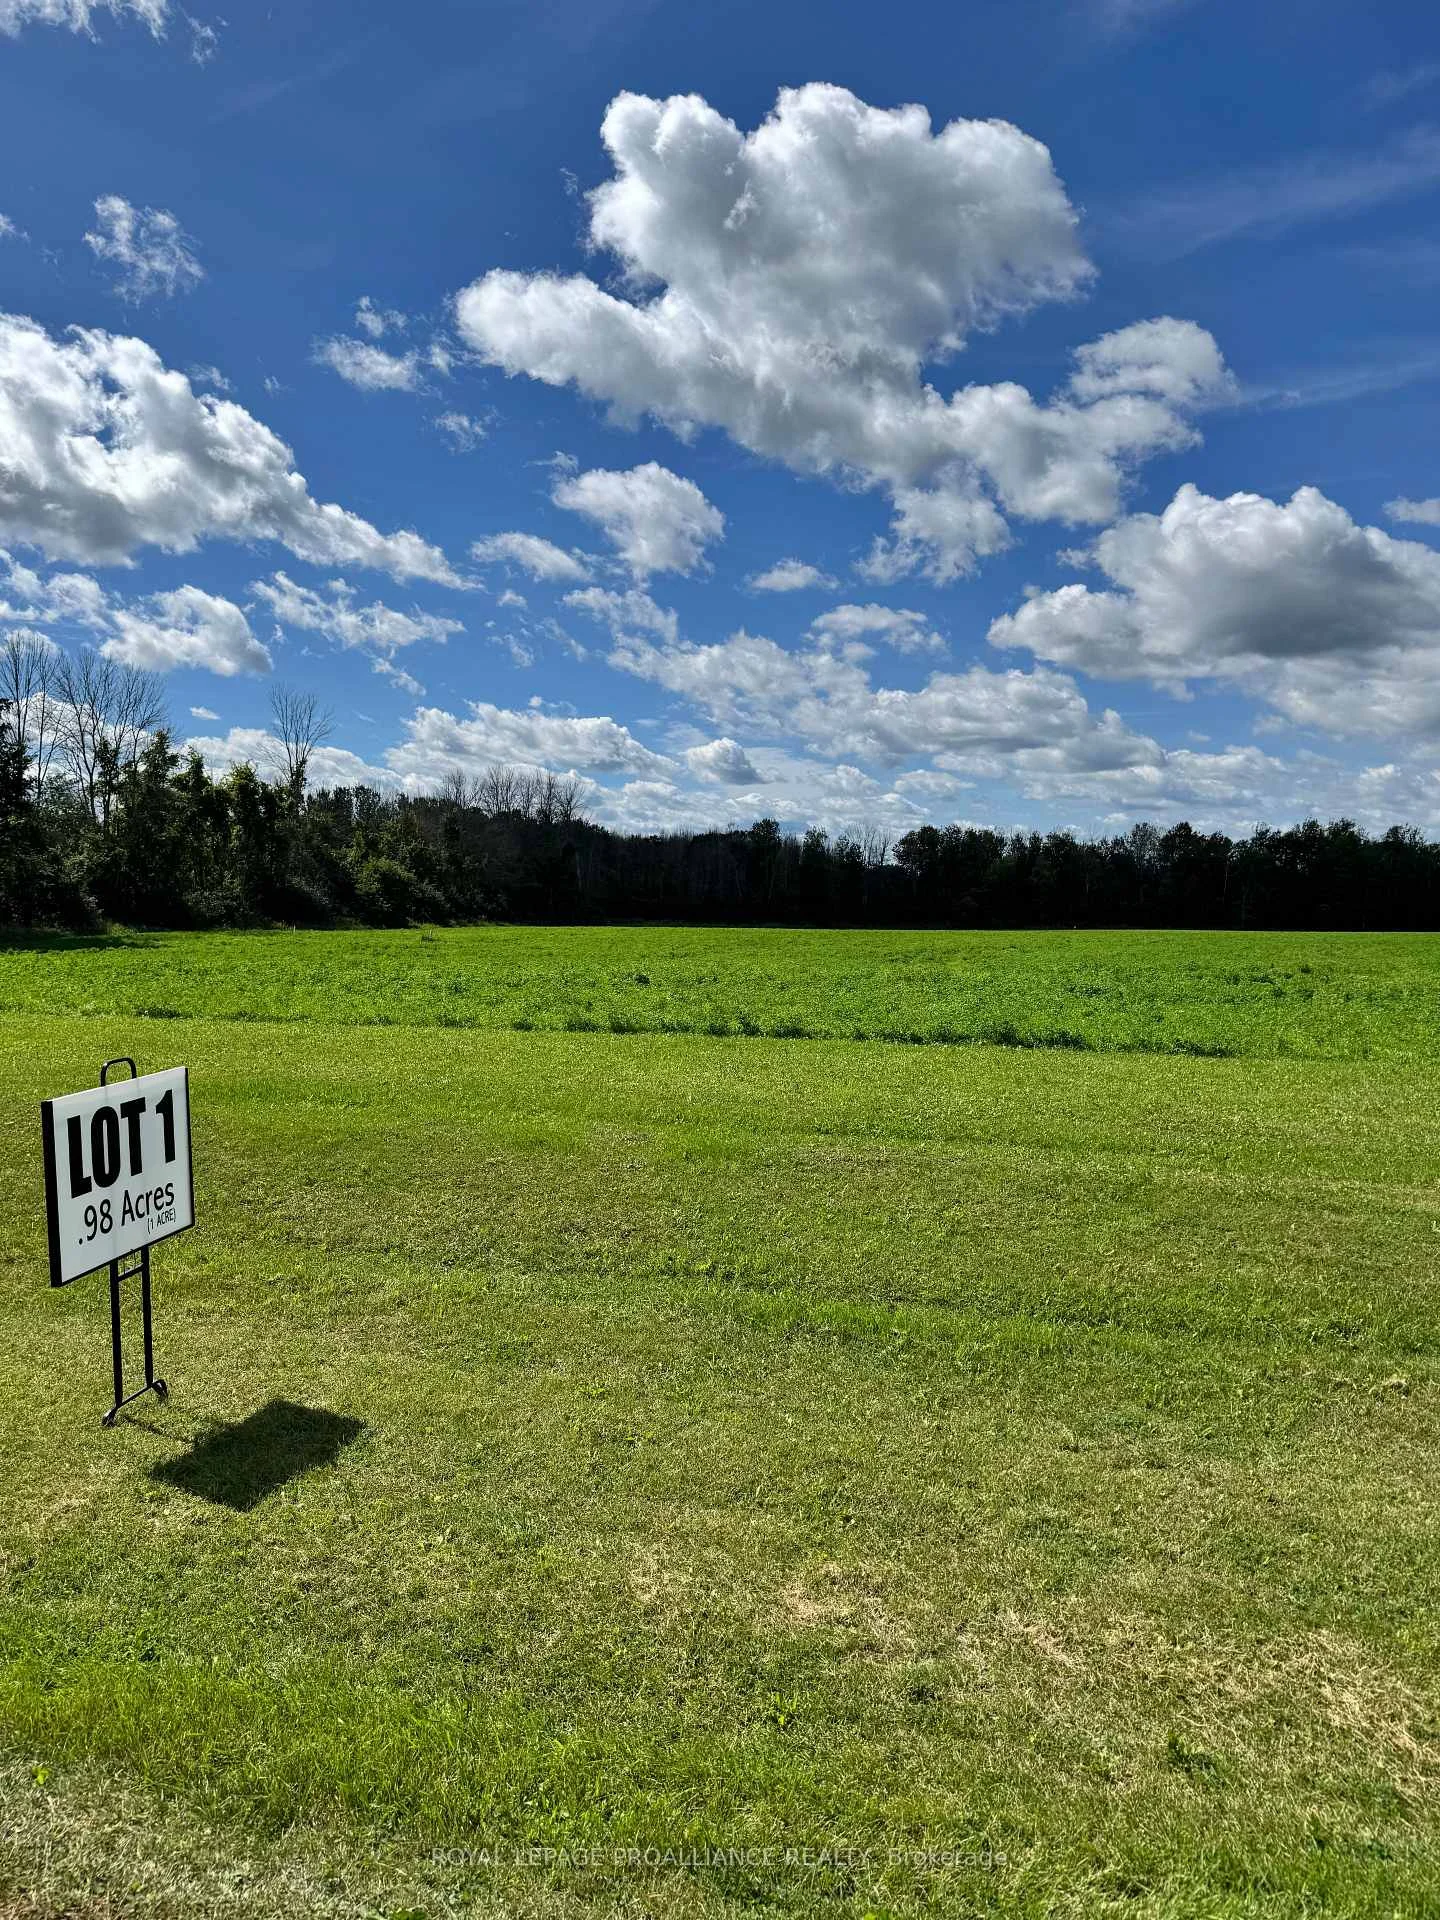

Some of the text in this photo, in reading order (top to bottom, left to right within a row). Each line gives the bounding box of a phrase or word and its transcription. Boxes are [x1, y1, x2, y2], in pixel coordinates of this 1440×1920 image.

[67, 1089, 176, 1198] LOT 1
[78, 1182, 174, 1245] .98 Acres
[147, 1208, 176, 1235] (1 ACRE)
